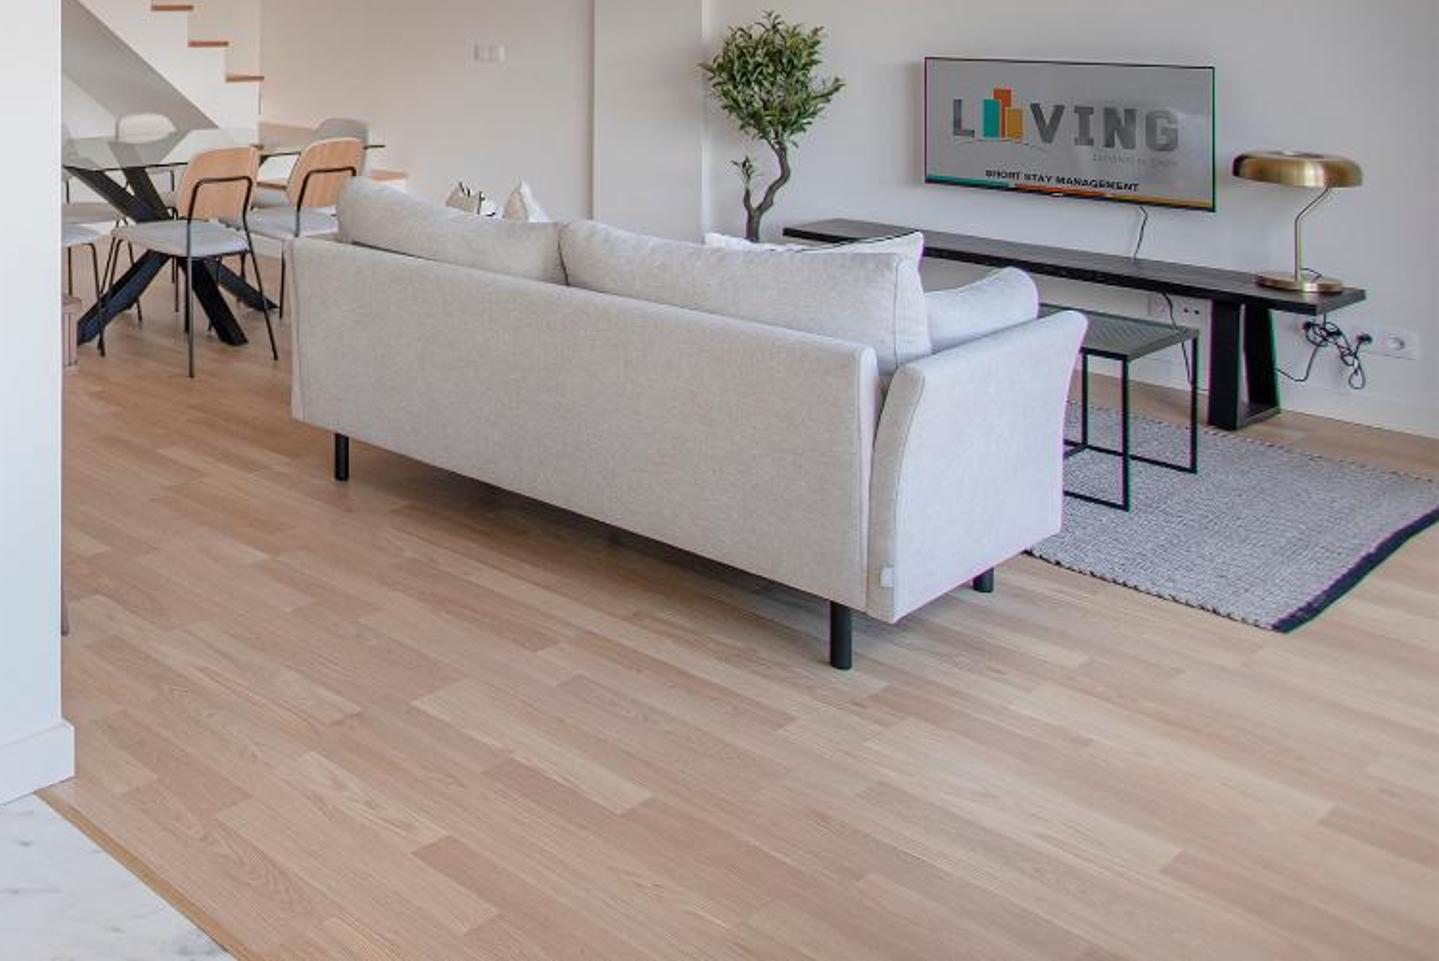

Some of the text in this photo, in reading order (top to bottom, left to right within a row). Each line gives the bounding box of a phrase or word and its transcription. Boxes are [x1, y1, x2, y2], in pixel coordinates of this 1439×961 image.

[985, 169, 1140, 192] SHORT STAY MANAGEMENT
